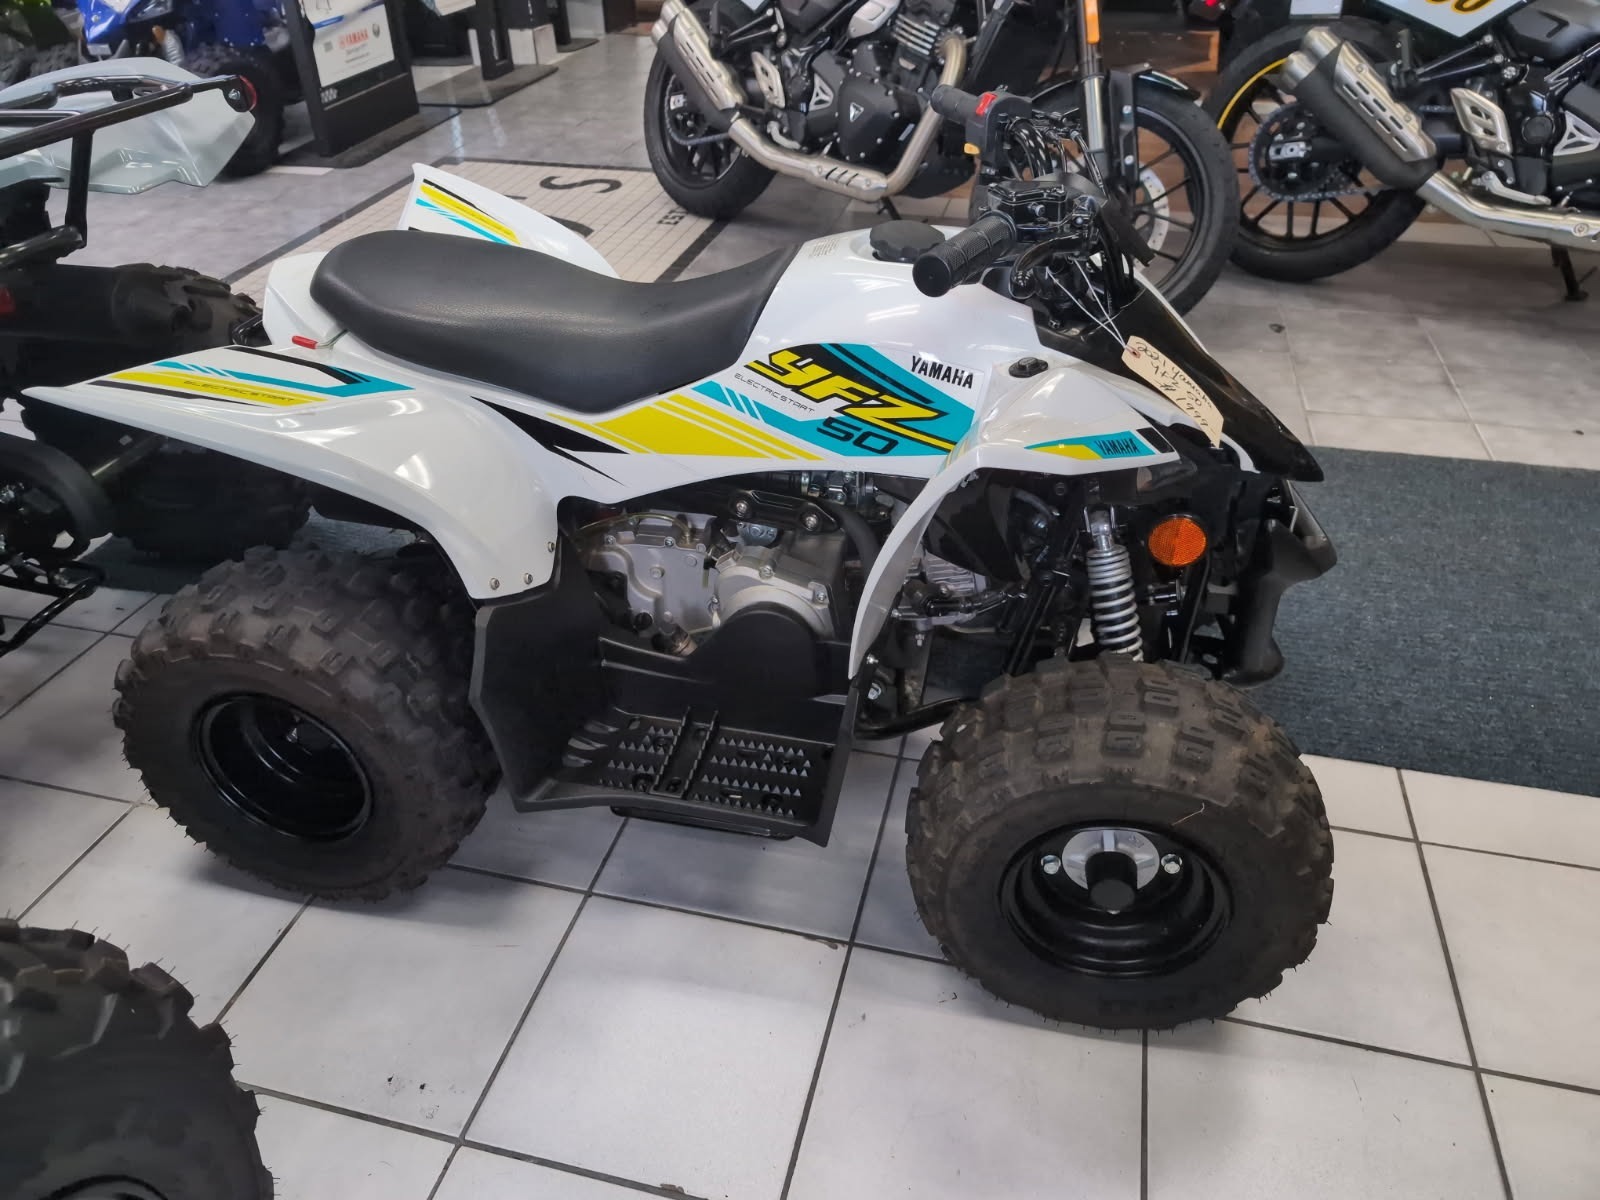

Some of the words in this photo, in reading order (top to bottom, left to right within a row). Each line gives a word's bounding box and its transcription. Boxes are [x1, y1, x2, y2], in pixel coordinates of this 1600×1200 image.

[910, 355, 974, 389] YAMAHA
[743, 349, 957, 452] YFZ
[816, 416, 899, 455] 50
[1094, 437, 1139, 456] YAMAHA
